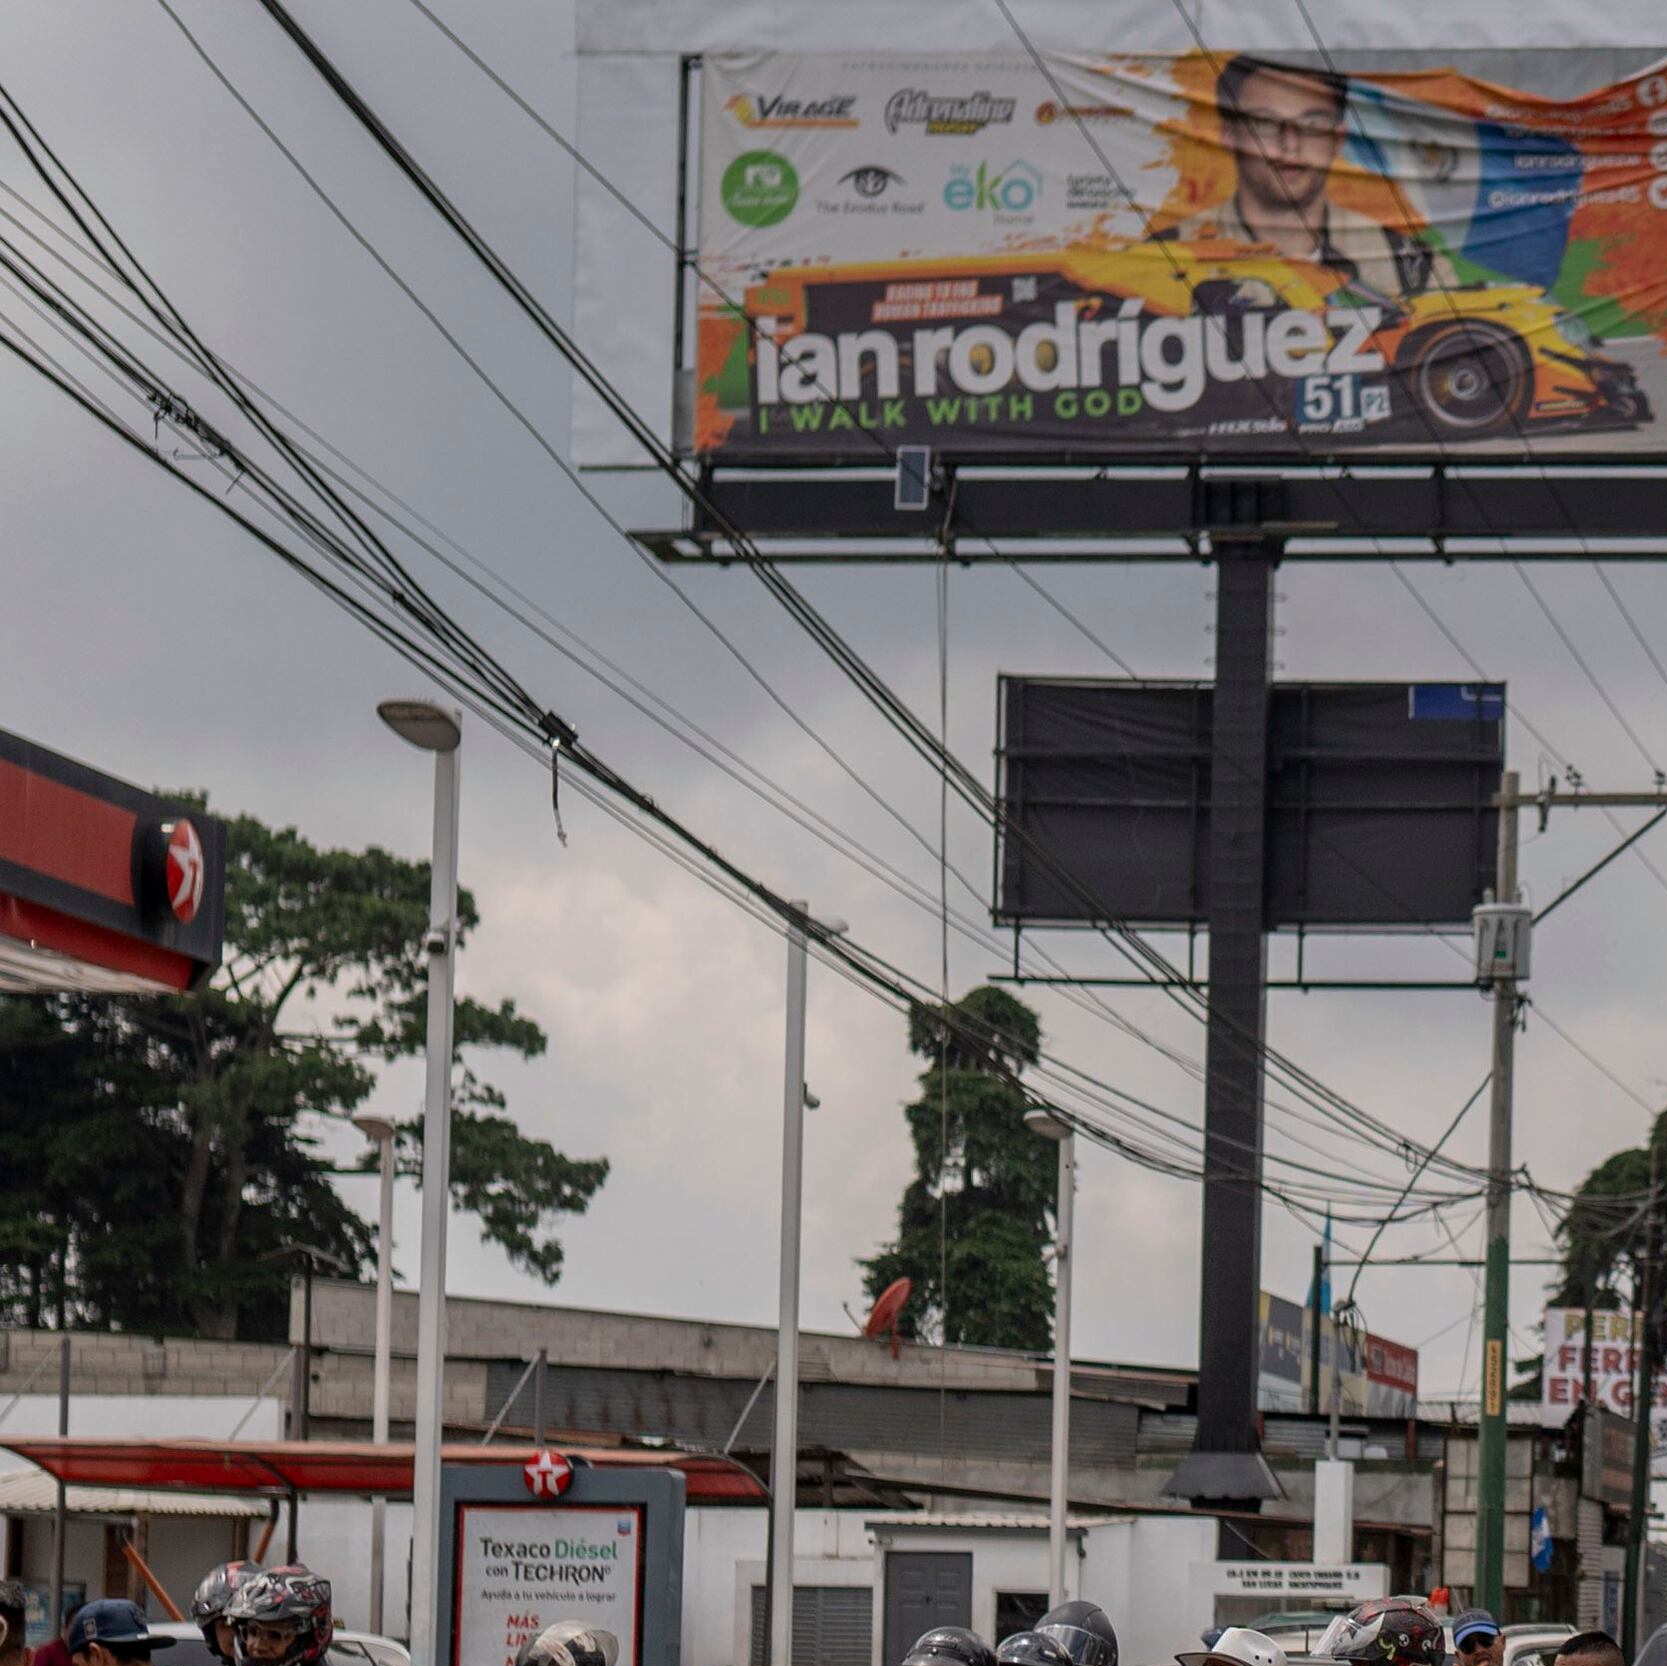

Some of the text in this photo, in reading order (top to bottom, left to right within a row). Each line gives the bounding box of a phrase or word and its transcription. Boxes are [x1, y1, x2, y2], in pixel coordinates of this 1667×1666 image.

[943, 161, 1034, 211] eko
[914, 297, 1384, 411] rodríguez
[759, 388, 1144, 435] I WALK WITH GOD
[1304, 376, 1361, 420] 51
[480, 1536, 618, 1560] Texaco Diésel
[485, 1564, 509, 1577] con
[481, 1589, 512, 1602] Ayuda
[506, 1610, 540, 1630] MÁS
